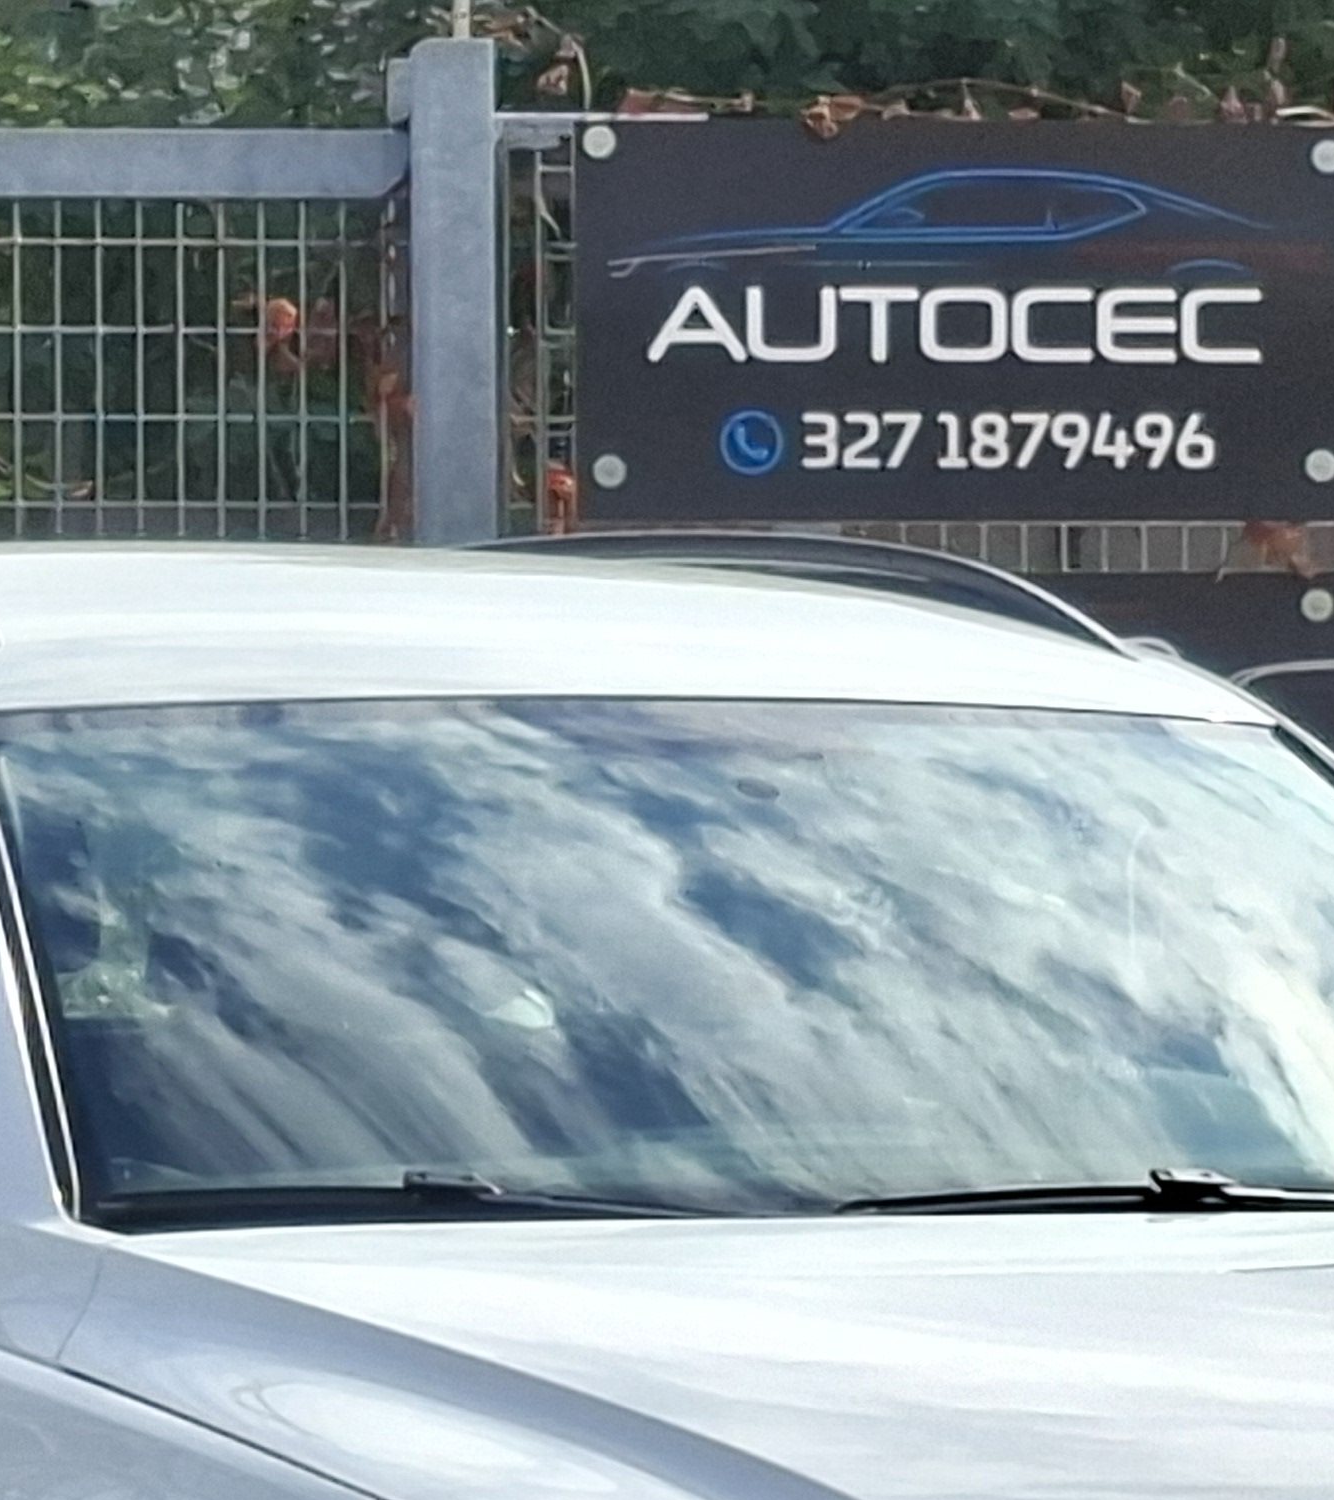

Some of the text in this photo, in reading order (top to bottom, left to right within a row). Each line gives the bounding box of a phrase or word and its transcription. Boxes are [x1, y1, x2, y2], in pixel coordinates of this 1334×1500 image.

[646, 284, 1264, 365] AUTOCEC
[800, 411, 1218, 472] 327 1879496
